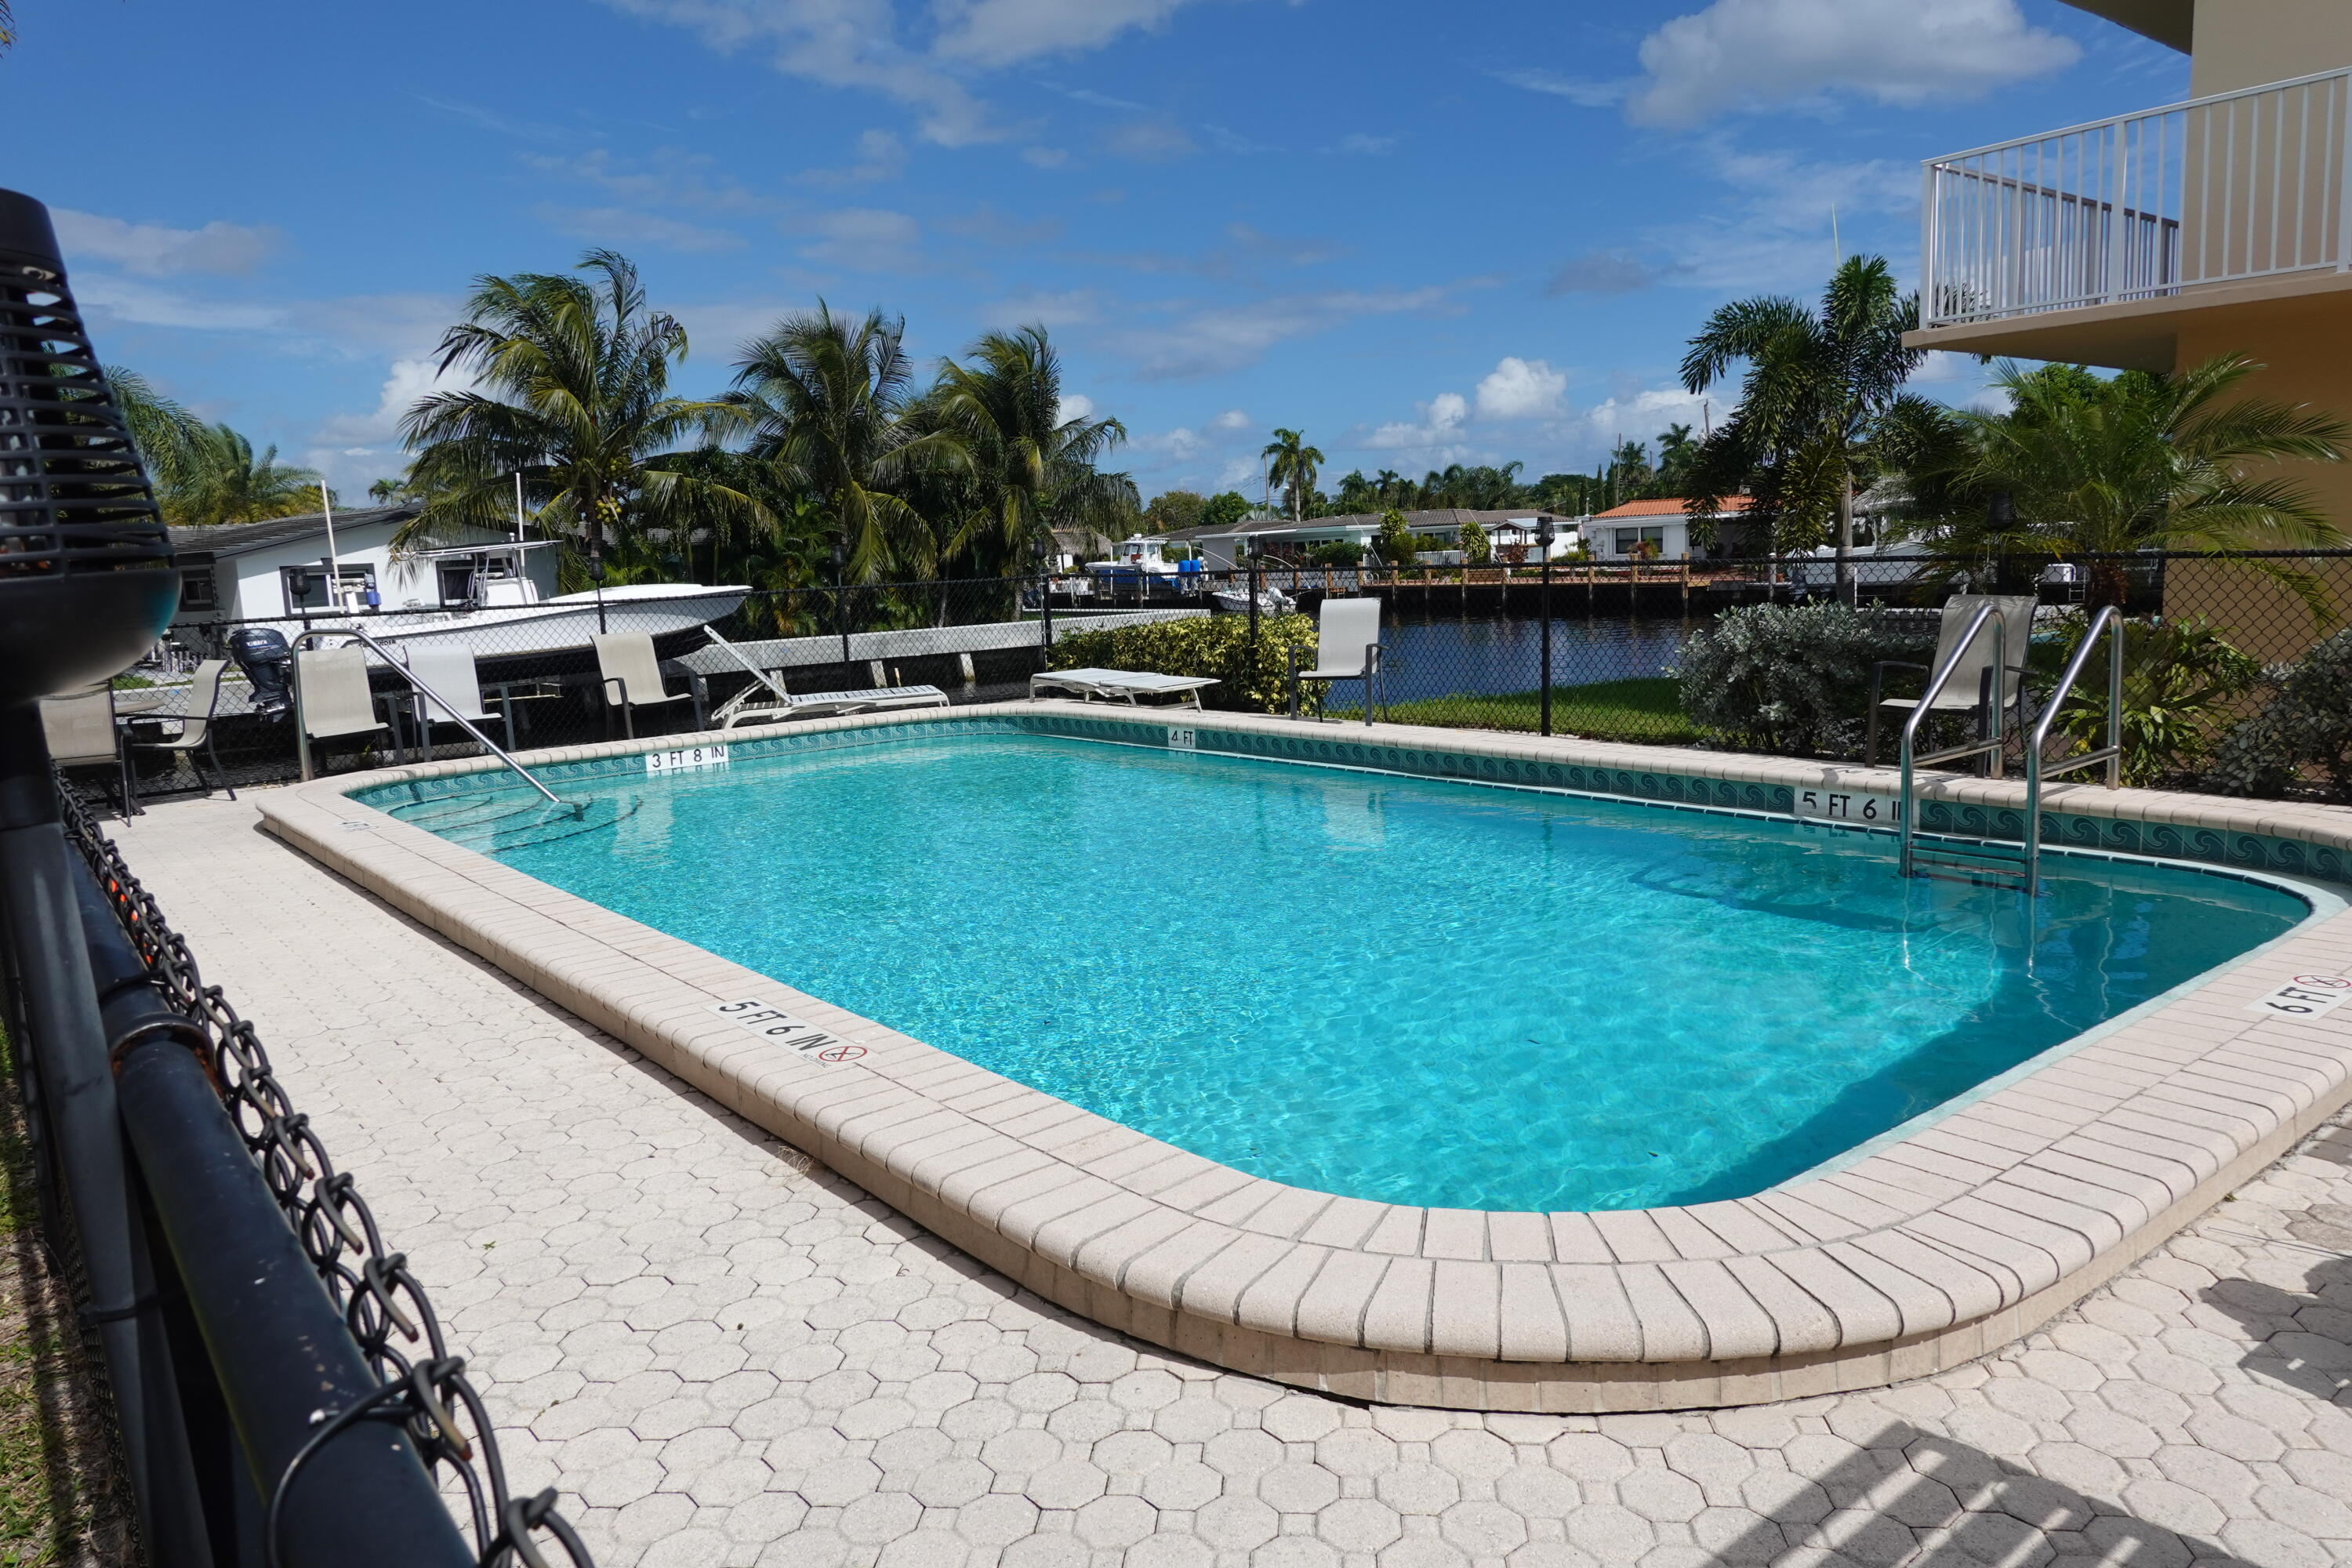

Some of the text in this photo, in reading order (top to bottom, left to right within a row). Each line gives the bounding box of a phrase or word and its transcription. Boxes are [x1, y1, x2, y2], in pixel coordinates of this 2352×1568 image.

[1171, 730, 1193, 746] 4 FT
[652, 746, 724, 768] 3 FT 8 IN
[1802, 791, 1817, 814] 5
[1829, 793, 1850, 817] FT
[1863, 798, 1877, 820] 6
[2276, 986, 2336, 1004] FT
[2264, 1002, 2314, 1013] 6
[719, 1001, 838, 1051] 5 FT 6 IN
